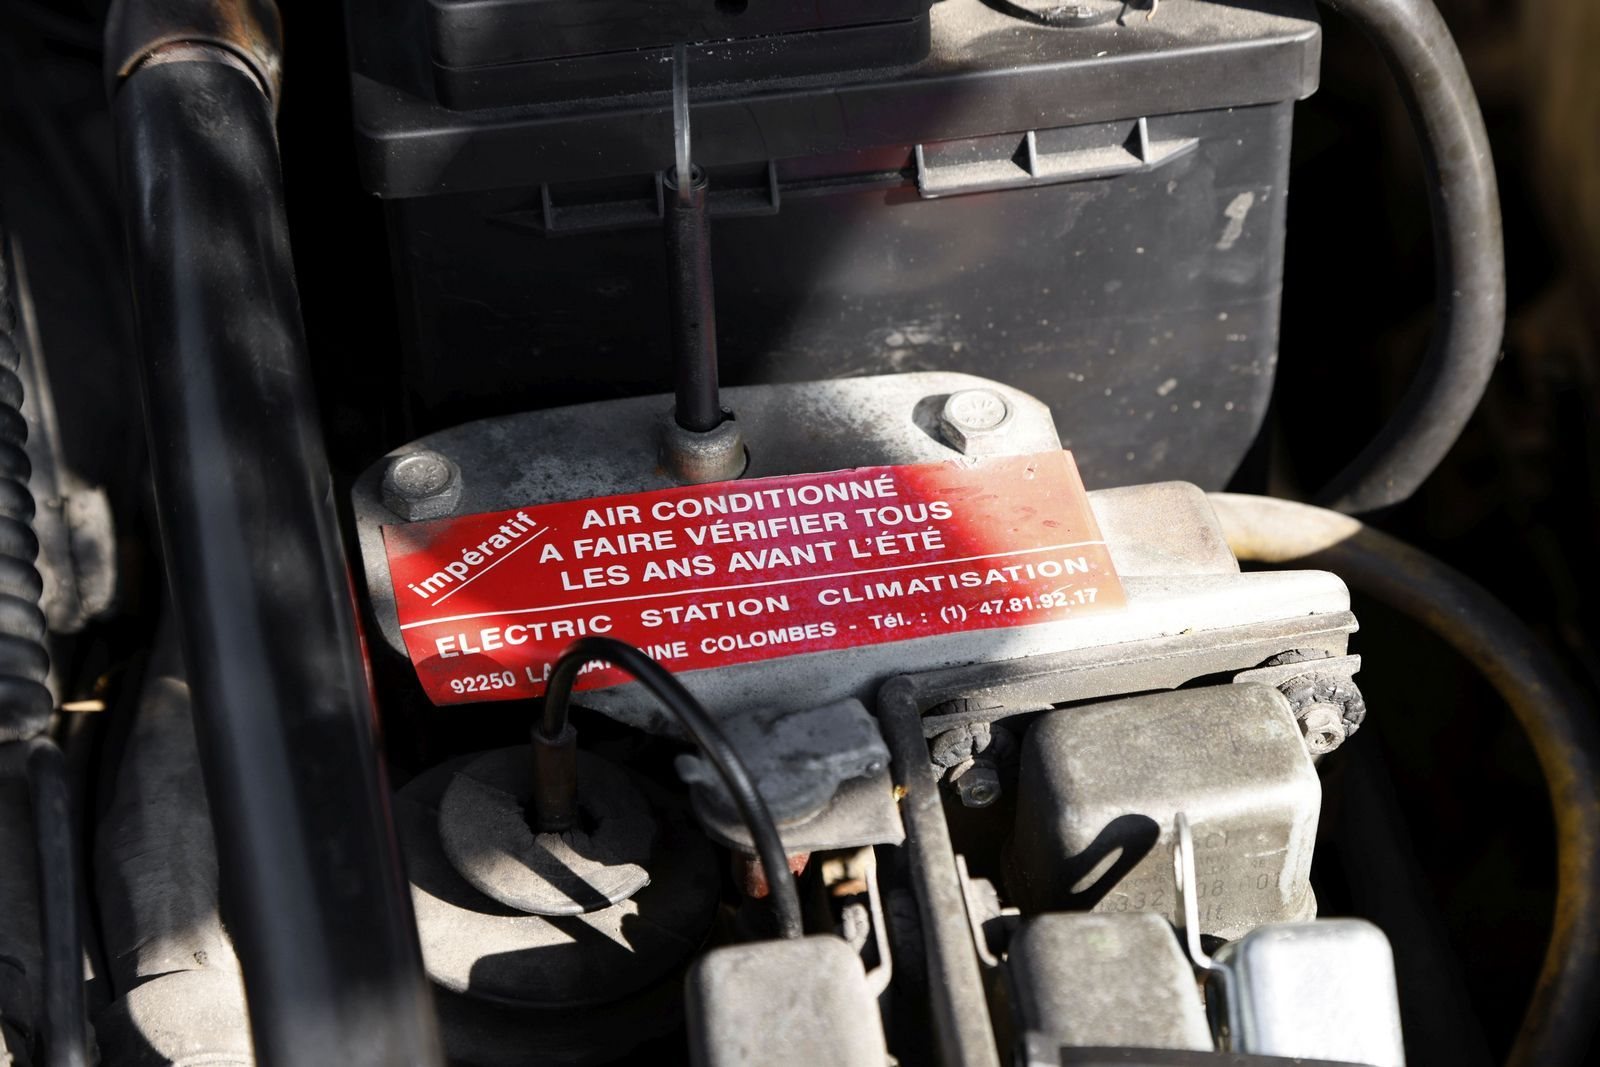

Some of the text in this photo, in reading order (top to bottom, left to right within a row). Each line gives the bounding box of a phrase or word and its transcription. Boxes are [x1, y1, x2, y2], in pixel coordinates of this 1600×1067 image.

[539, 500, 953, 563] A FAIRE VÉRIFIER TOUS
[582, 474, 898, 529] AIR CONDITIONNÉ
[408, 511, 537, 599] impératif
[561, 526, 946, 591] LES ANS AVANT L'ÉTÉ
[435, 556, 1089, 659] ELECTRIC STATION CLIMATISATION
[450, 671, 516, 694] 92250
[700, 622, 837, 654] COLOMBES
[868, 611, 912, 630] Tél.
[940, 604, 967, 624] (1)
[979, 588, 1098, 616] 47.81.92.17
